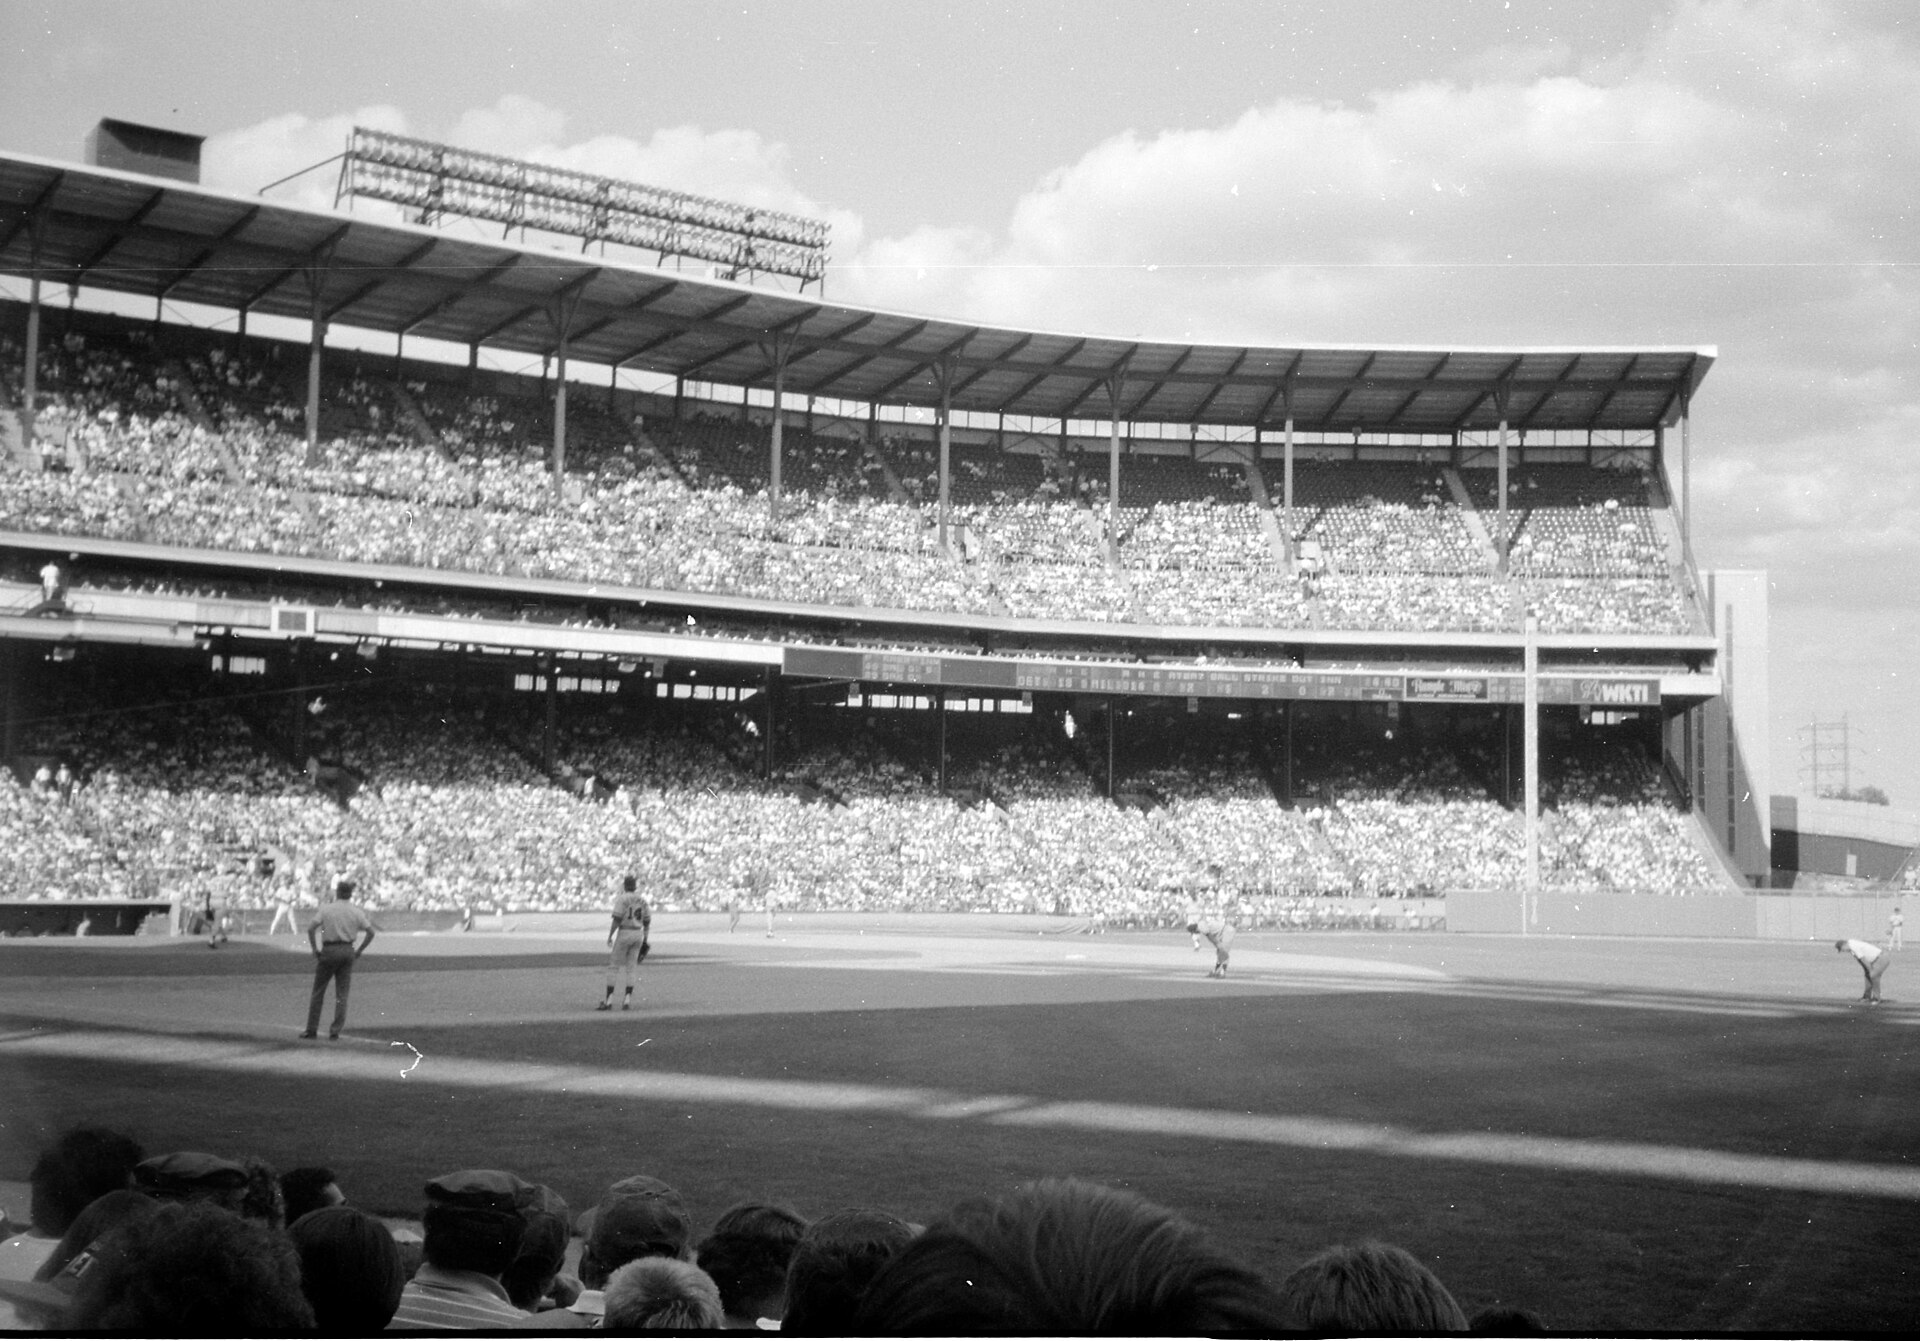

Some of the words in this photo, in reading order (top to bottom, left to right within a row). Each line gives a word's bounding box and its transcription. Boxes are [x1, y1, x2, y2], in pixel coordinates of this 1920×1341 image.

[1017, 676, 1041, 688] DET
[1210, 673, 1239, 682] BALL
[1244, 673, 1287, 683] STRIKE
[1291, 674, 1313, 683] OUT
[1090, 679, 1114, 691] MIL
[1261, 684, 1270, 696] 2
[1602, 683, 1649, 703] WKTI
[627, 906, 643, 921] 14
